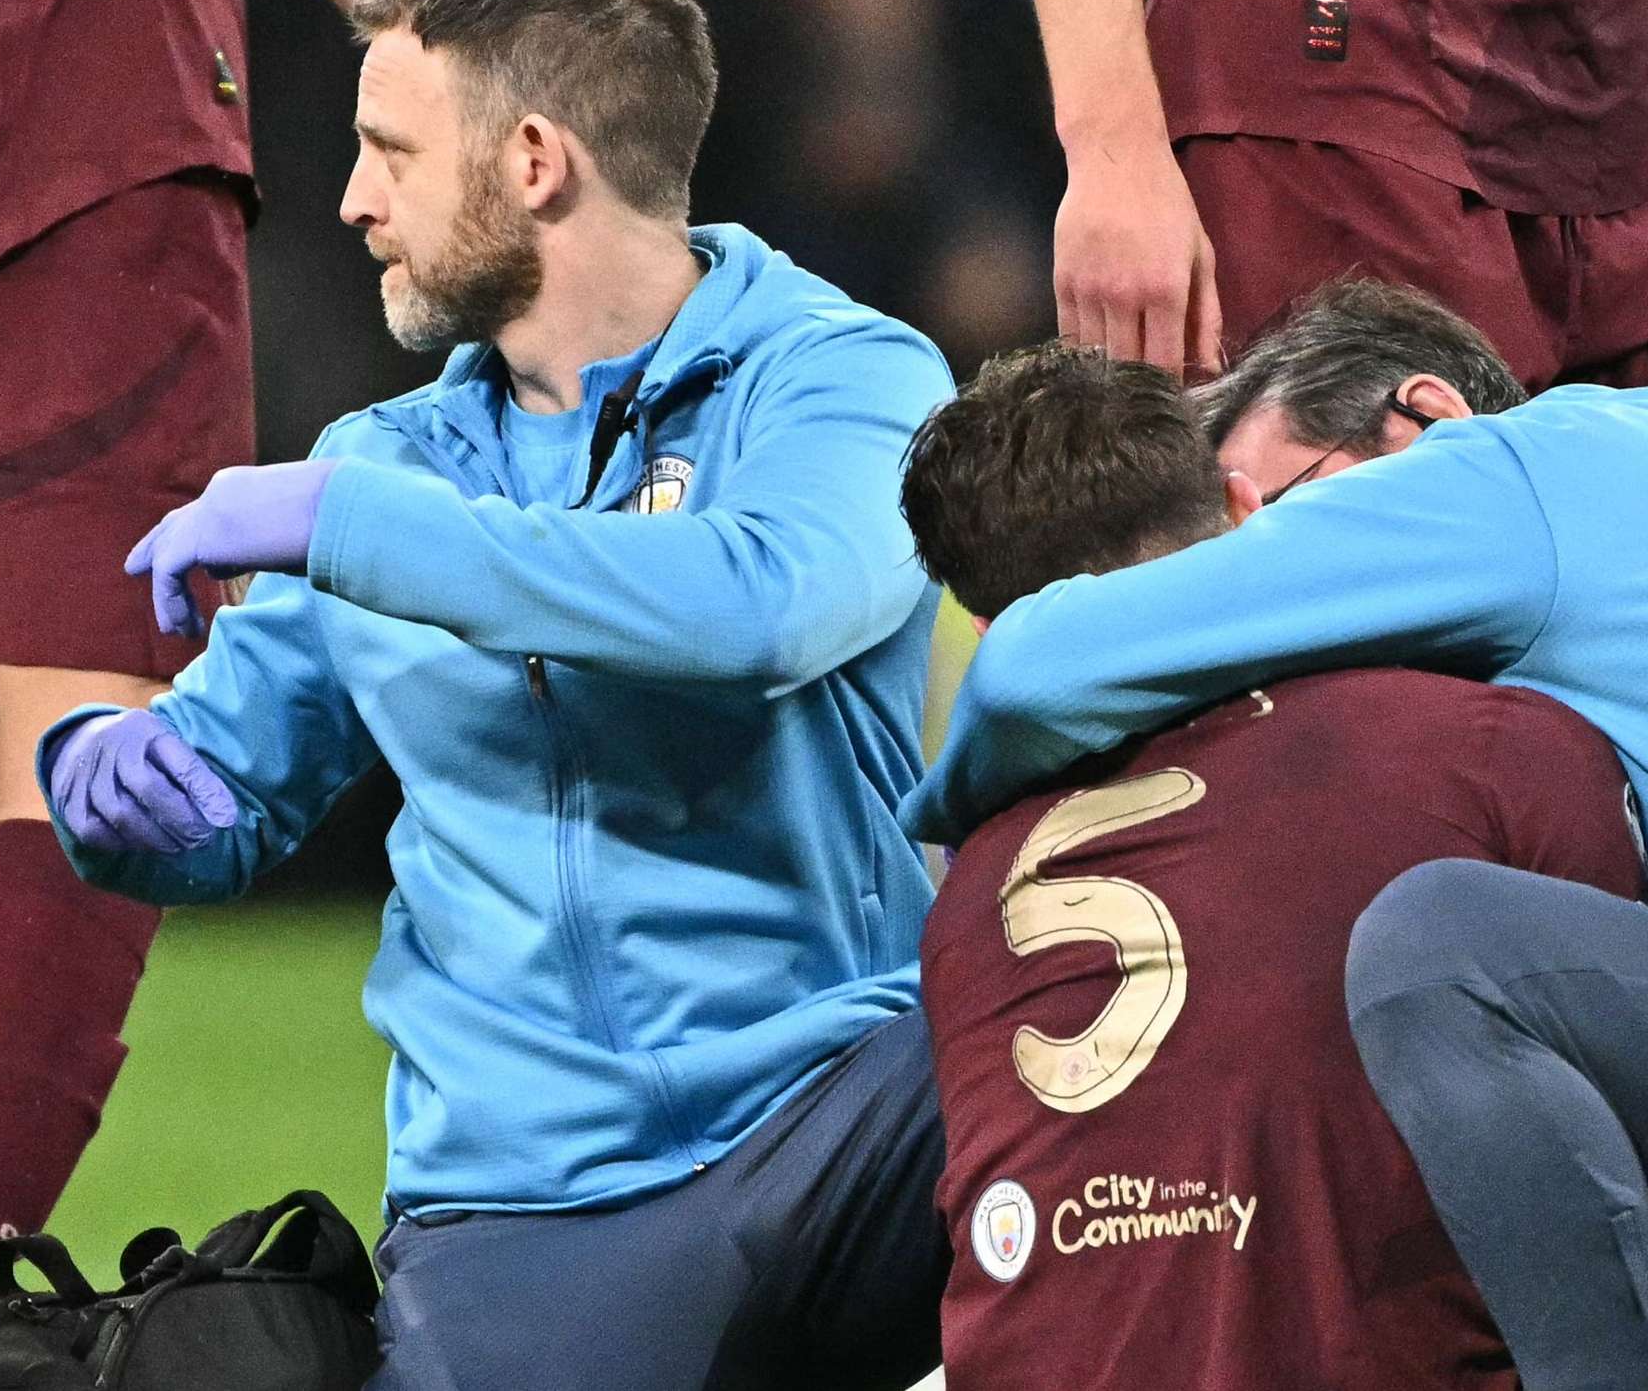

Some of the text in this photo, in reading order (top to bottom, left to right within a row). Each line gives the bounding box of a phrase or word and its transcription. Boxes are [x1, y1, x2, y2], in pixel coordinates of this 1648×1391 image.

[998, 766, 1208, 1114] 5
[1084, 1173, 1207, 1210] City in the
